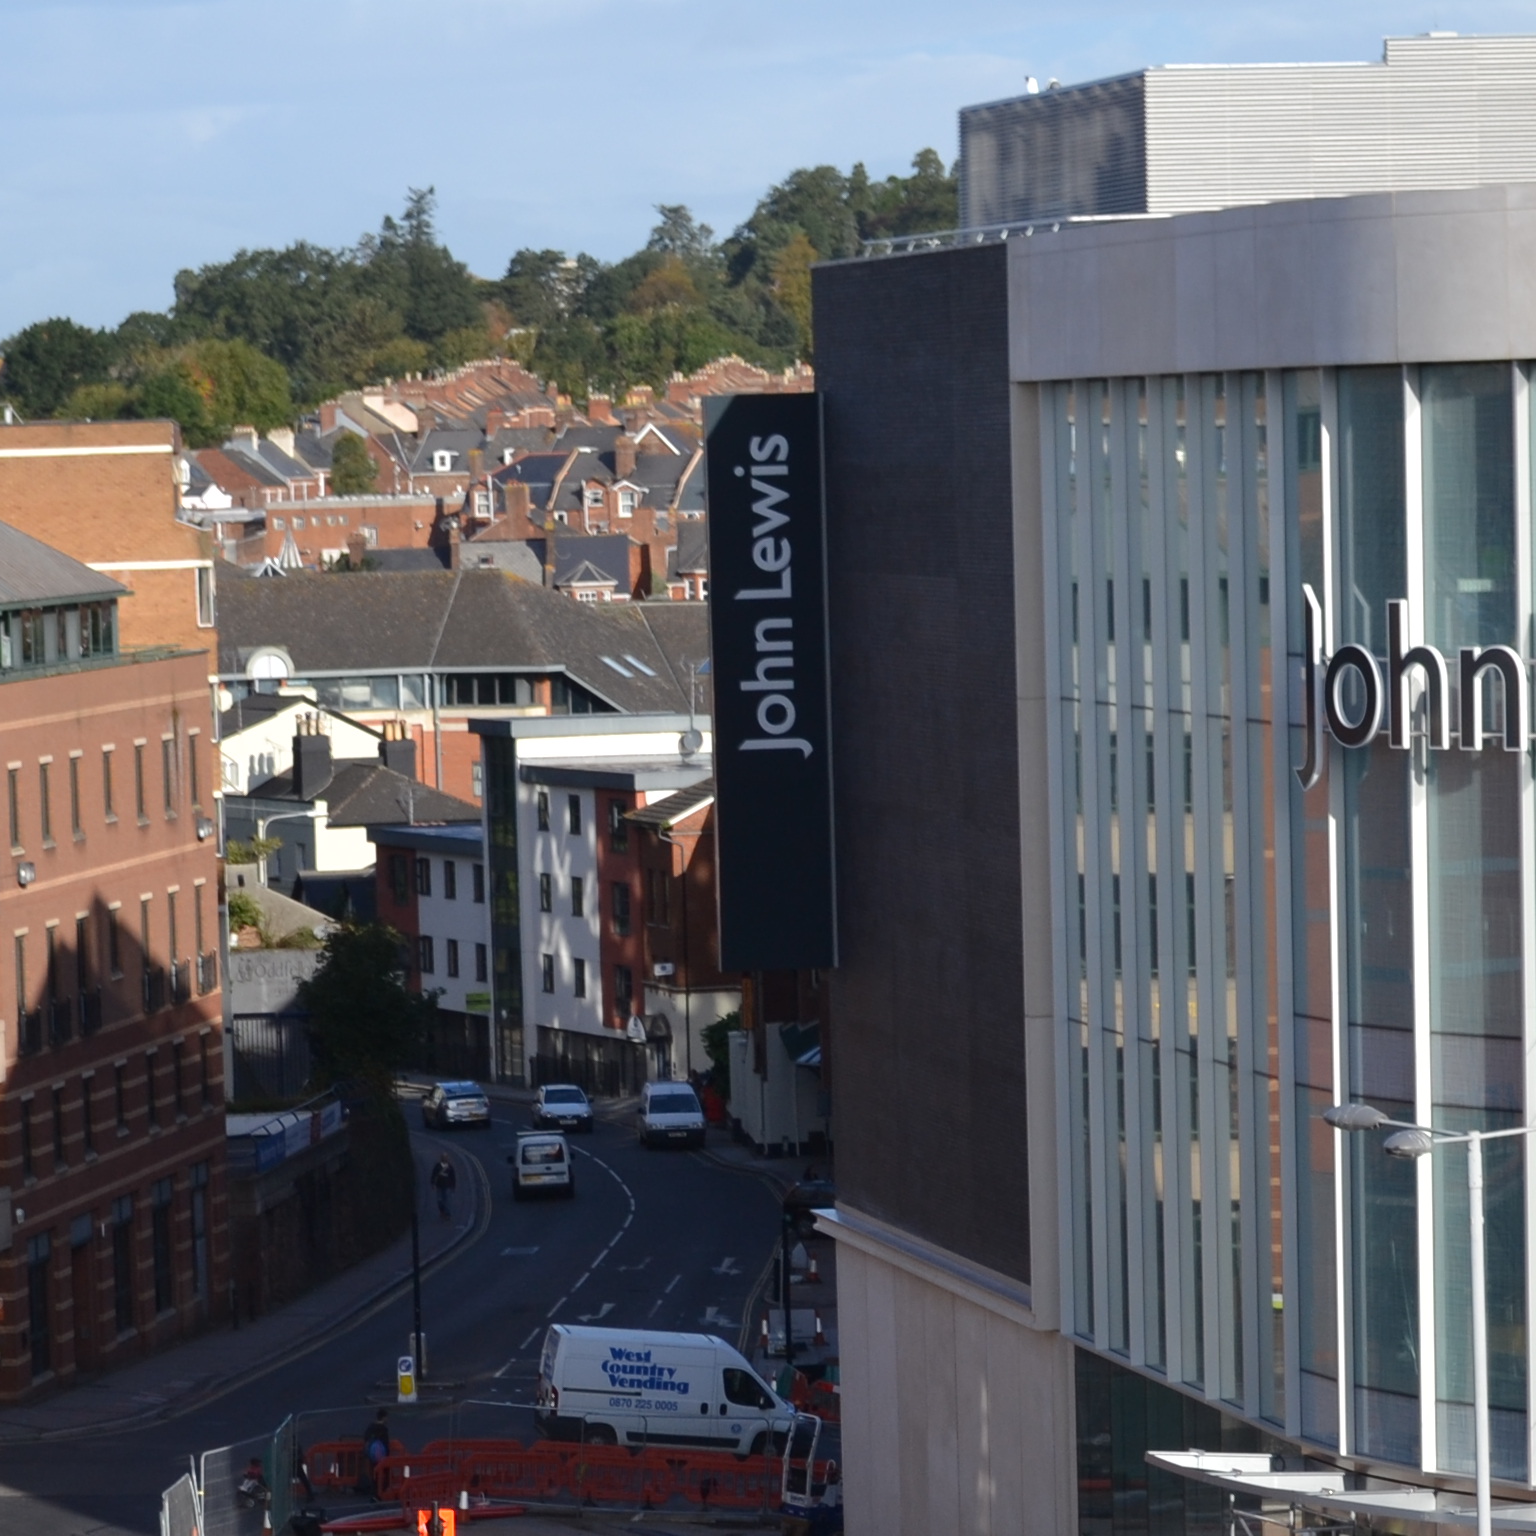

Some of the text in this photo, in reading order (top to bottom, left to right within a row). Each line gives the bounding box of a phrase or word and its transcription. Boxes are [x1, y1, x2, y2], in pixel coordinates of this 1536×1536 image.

[734, 432, 813, 759] John Lewis
[1295, 583, 1528, 790] John
[609, 1347, 651, 1363] West
[601, 1360, 677, 1380] Country
[608, 1374, 689, 1395] Vending
[609, 1397, 632, 1408] 0870
[634, 1399, 652, 1410] 225
